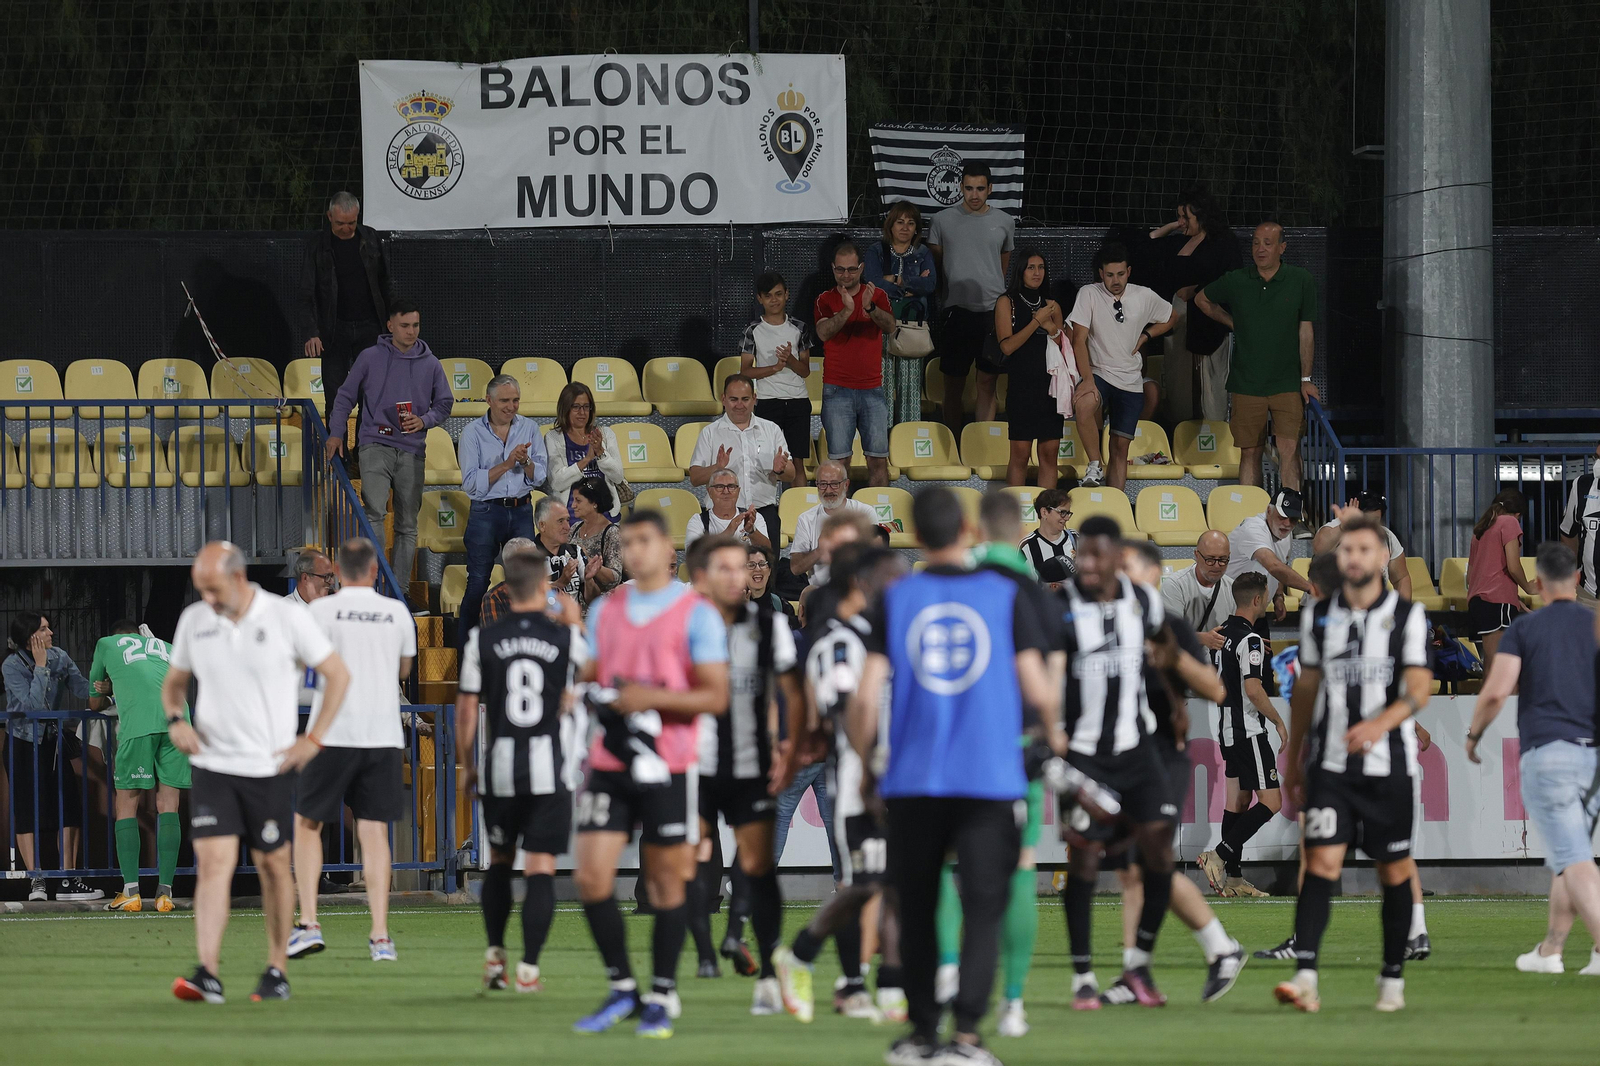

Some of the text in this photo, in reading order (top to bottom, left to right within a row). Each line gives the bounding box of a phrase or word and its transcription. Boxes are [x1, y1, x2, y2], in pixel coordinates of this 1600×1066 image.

[480, 62, 751, 110] BALONOS
[548, 125, 687, 157] POR EL
[759, 108, 775, 162] BALONOS
[781, 130, 801, 143] BL
[802, 106, 824, 178] POR EL MUNDO
[389, 145, 400, 170] REAL
[404, 184, 449, 198] LINENSE
[517, 172, 719, 219] MUNDO
[335, 609, 394, 624] LEGEA
[117, 636, 171, 665] 24
[505, 658, 545, 728] 8
[1305, 806, 1338, 839] 20
